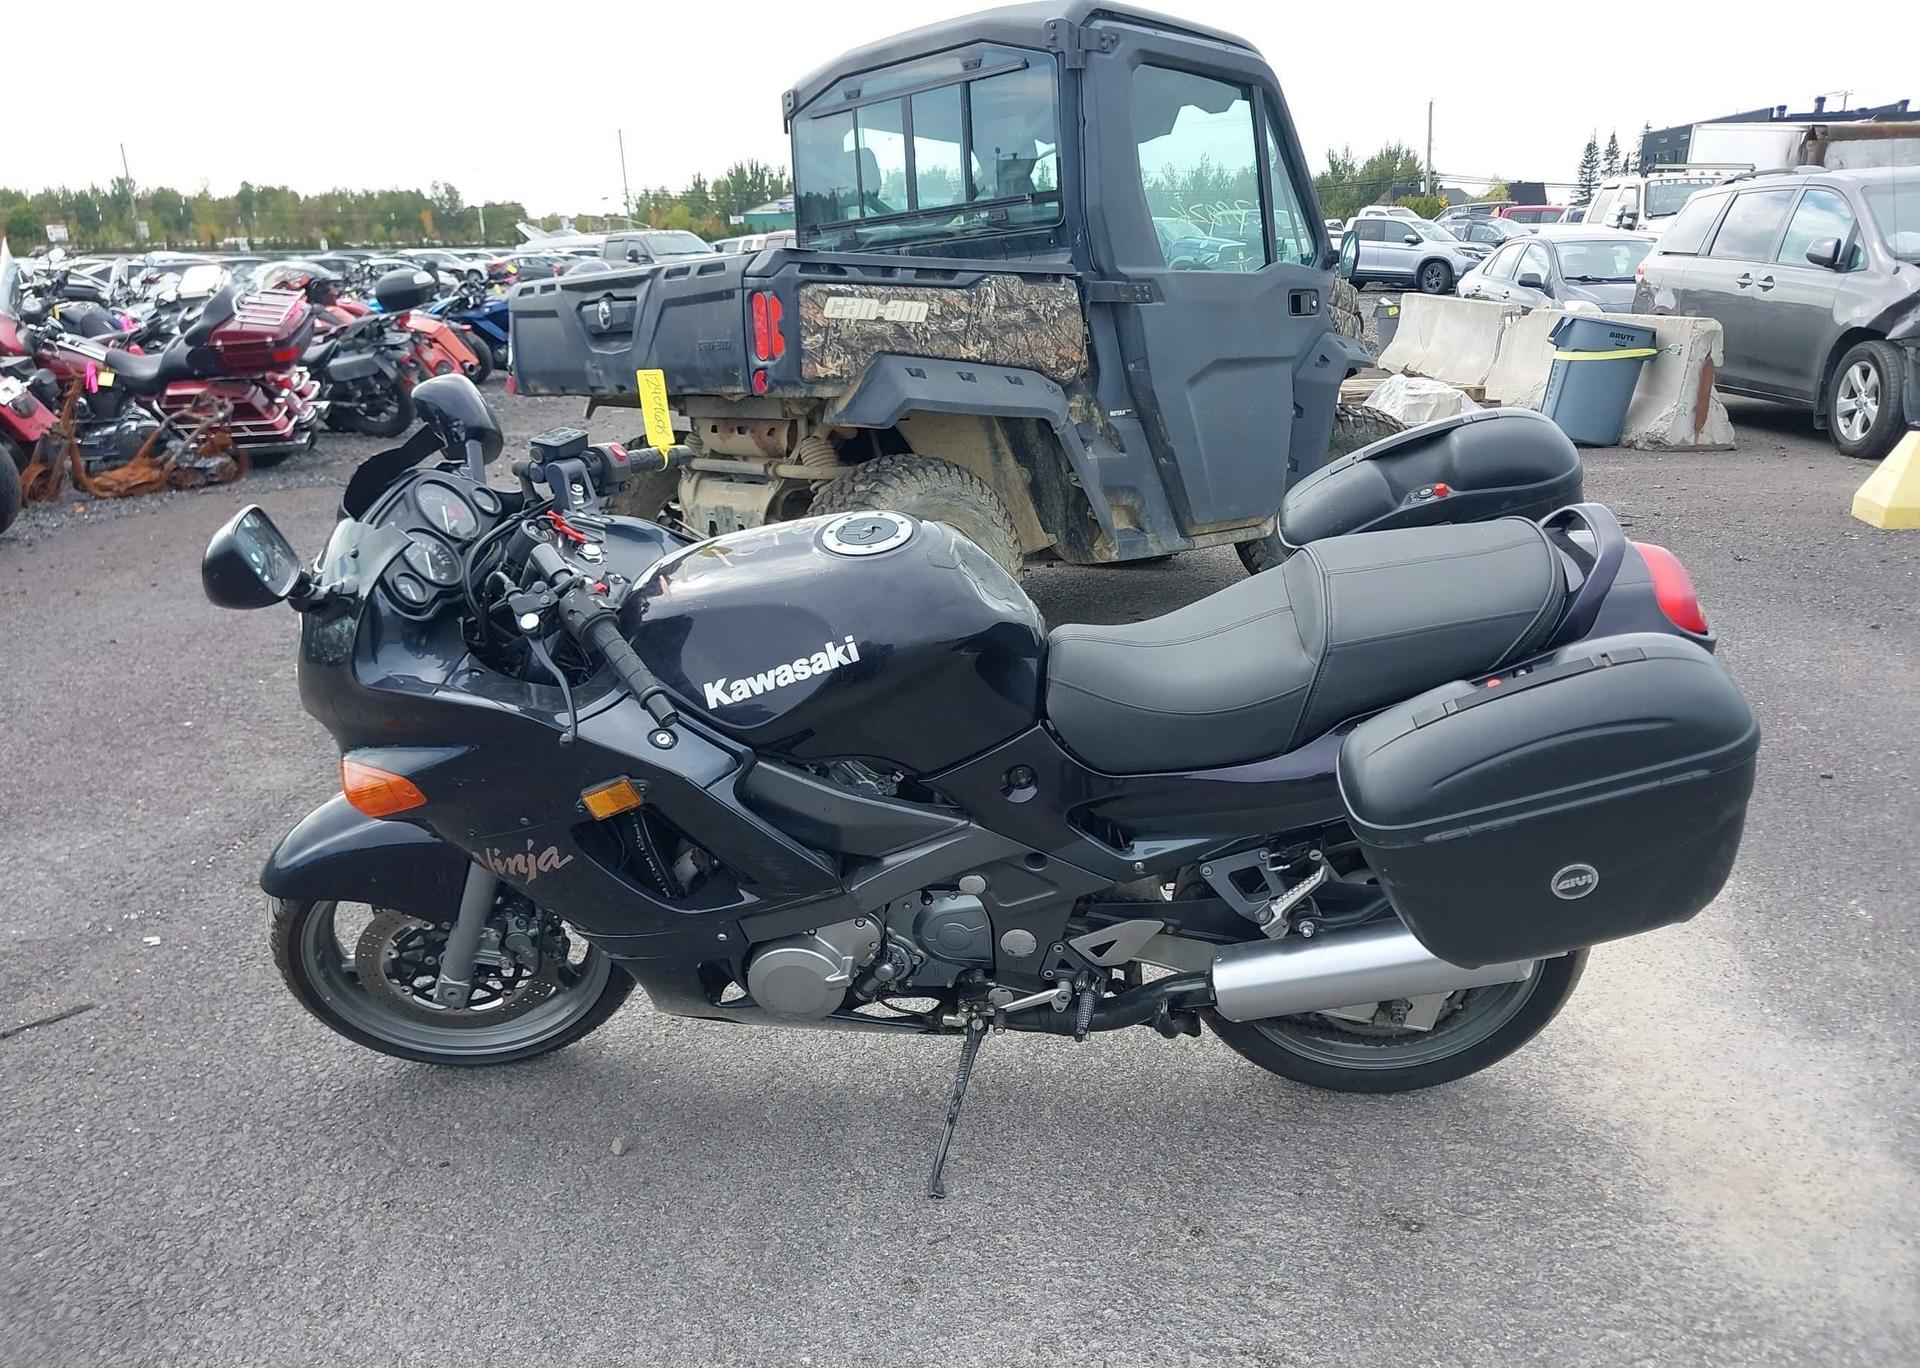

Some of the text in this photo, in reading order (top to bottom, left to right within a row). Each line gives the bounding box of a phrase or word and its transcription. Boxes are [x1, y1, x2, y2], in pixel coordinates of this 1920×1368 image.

[824, 297, 929, 322] can-am
[1609, 331, 1636, 342] BRUTE
[703, 634, 861, 710] Kawasaki
[1557, 874, 1593, 890] GIVI
